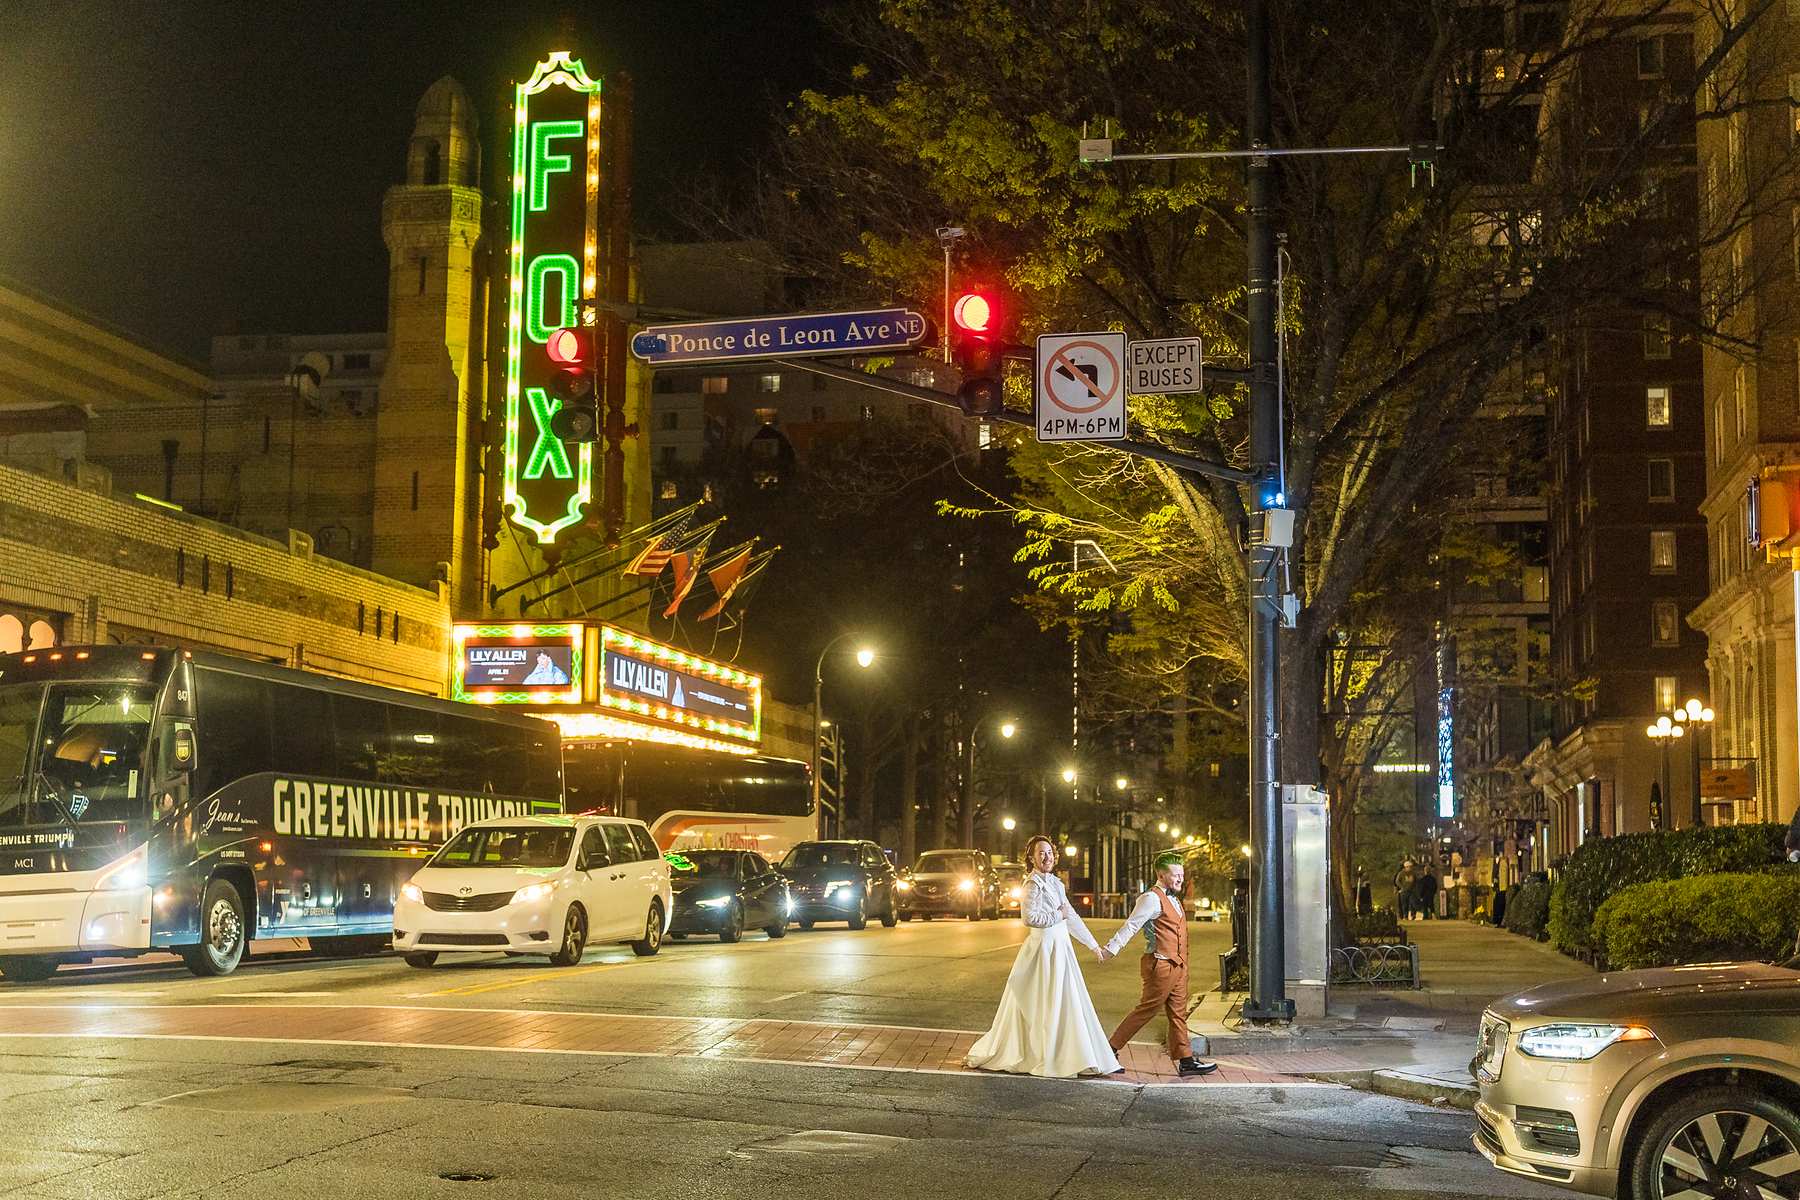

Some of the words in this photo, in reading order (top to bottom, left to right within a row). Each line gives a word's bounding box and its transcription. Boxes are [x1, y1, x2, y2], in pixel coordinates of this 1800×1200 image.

[523, 119, 584, 480] FOX
[668, 332, 736, 353] Ponce
[743, 328, 771, 348] de
[778, 325, 837, 346] Leon
[844, 321, 890, 342] Ave
[895, 319, 920, 335] NE
[1134, 343, 1197, 366] EXCEPT
[1138, 367, 1193, 388] BUSES
[1043, 416, 1121, 435] 4PM-6PM
[470, 650, 492, 661] LILY
[491, 650, 527, 661] ALLEN
[613, 656, 636, 690] LILY
[634, 663, 669, 699] ALLEN
[273, 778, 431, 841] GREENVILLE
[34, 833, 75, 844] TRIUMPH
[14, 858, 34, 869] MCI
